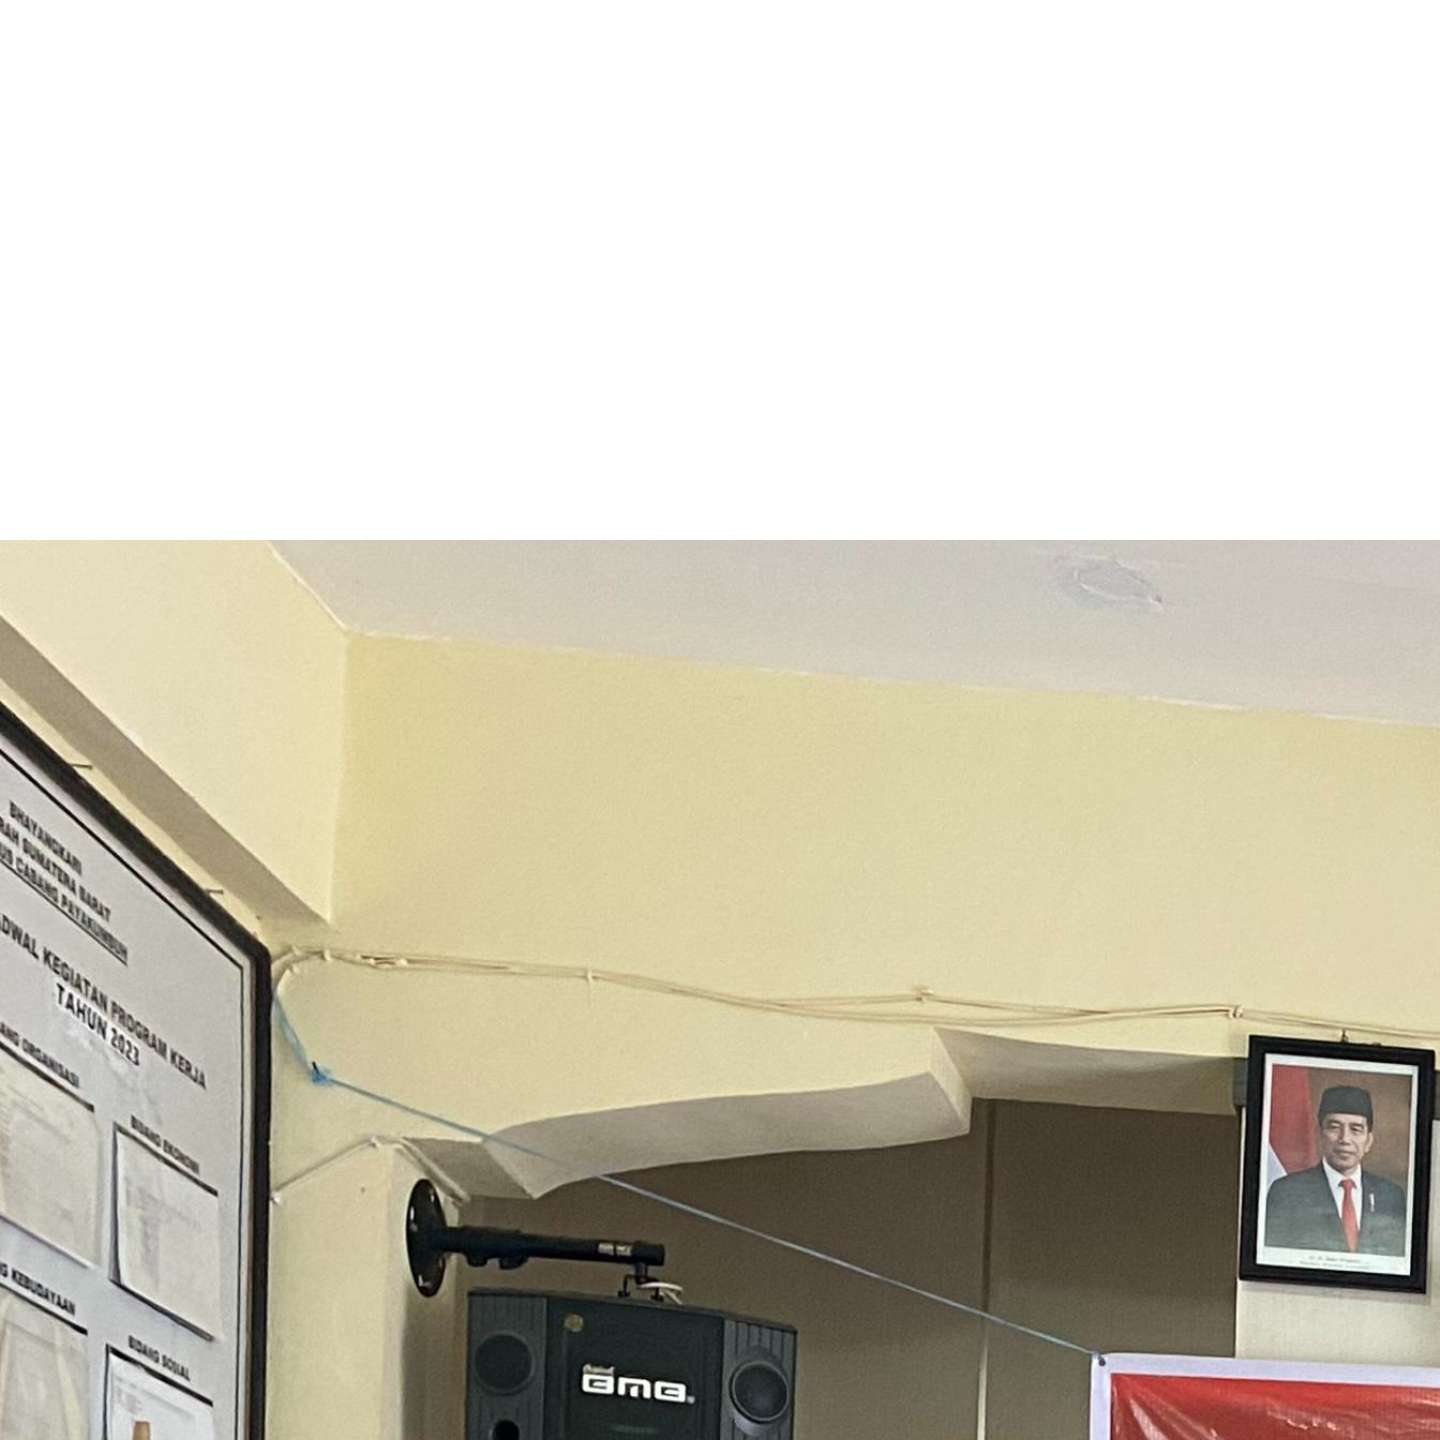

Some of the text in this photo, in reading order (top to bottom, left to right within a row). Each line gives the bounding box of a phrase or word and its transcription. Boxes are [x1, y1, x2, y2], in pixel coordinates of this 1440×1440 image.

[0, 913, 207, 1090] DWAL KEGIATAN PROGRAM KERJA
[56, 982, 107, 1040] TAHUN
